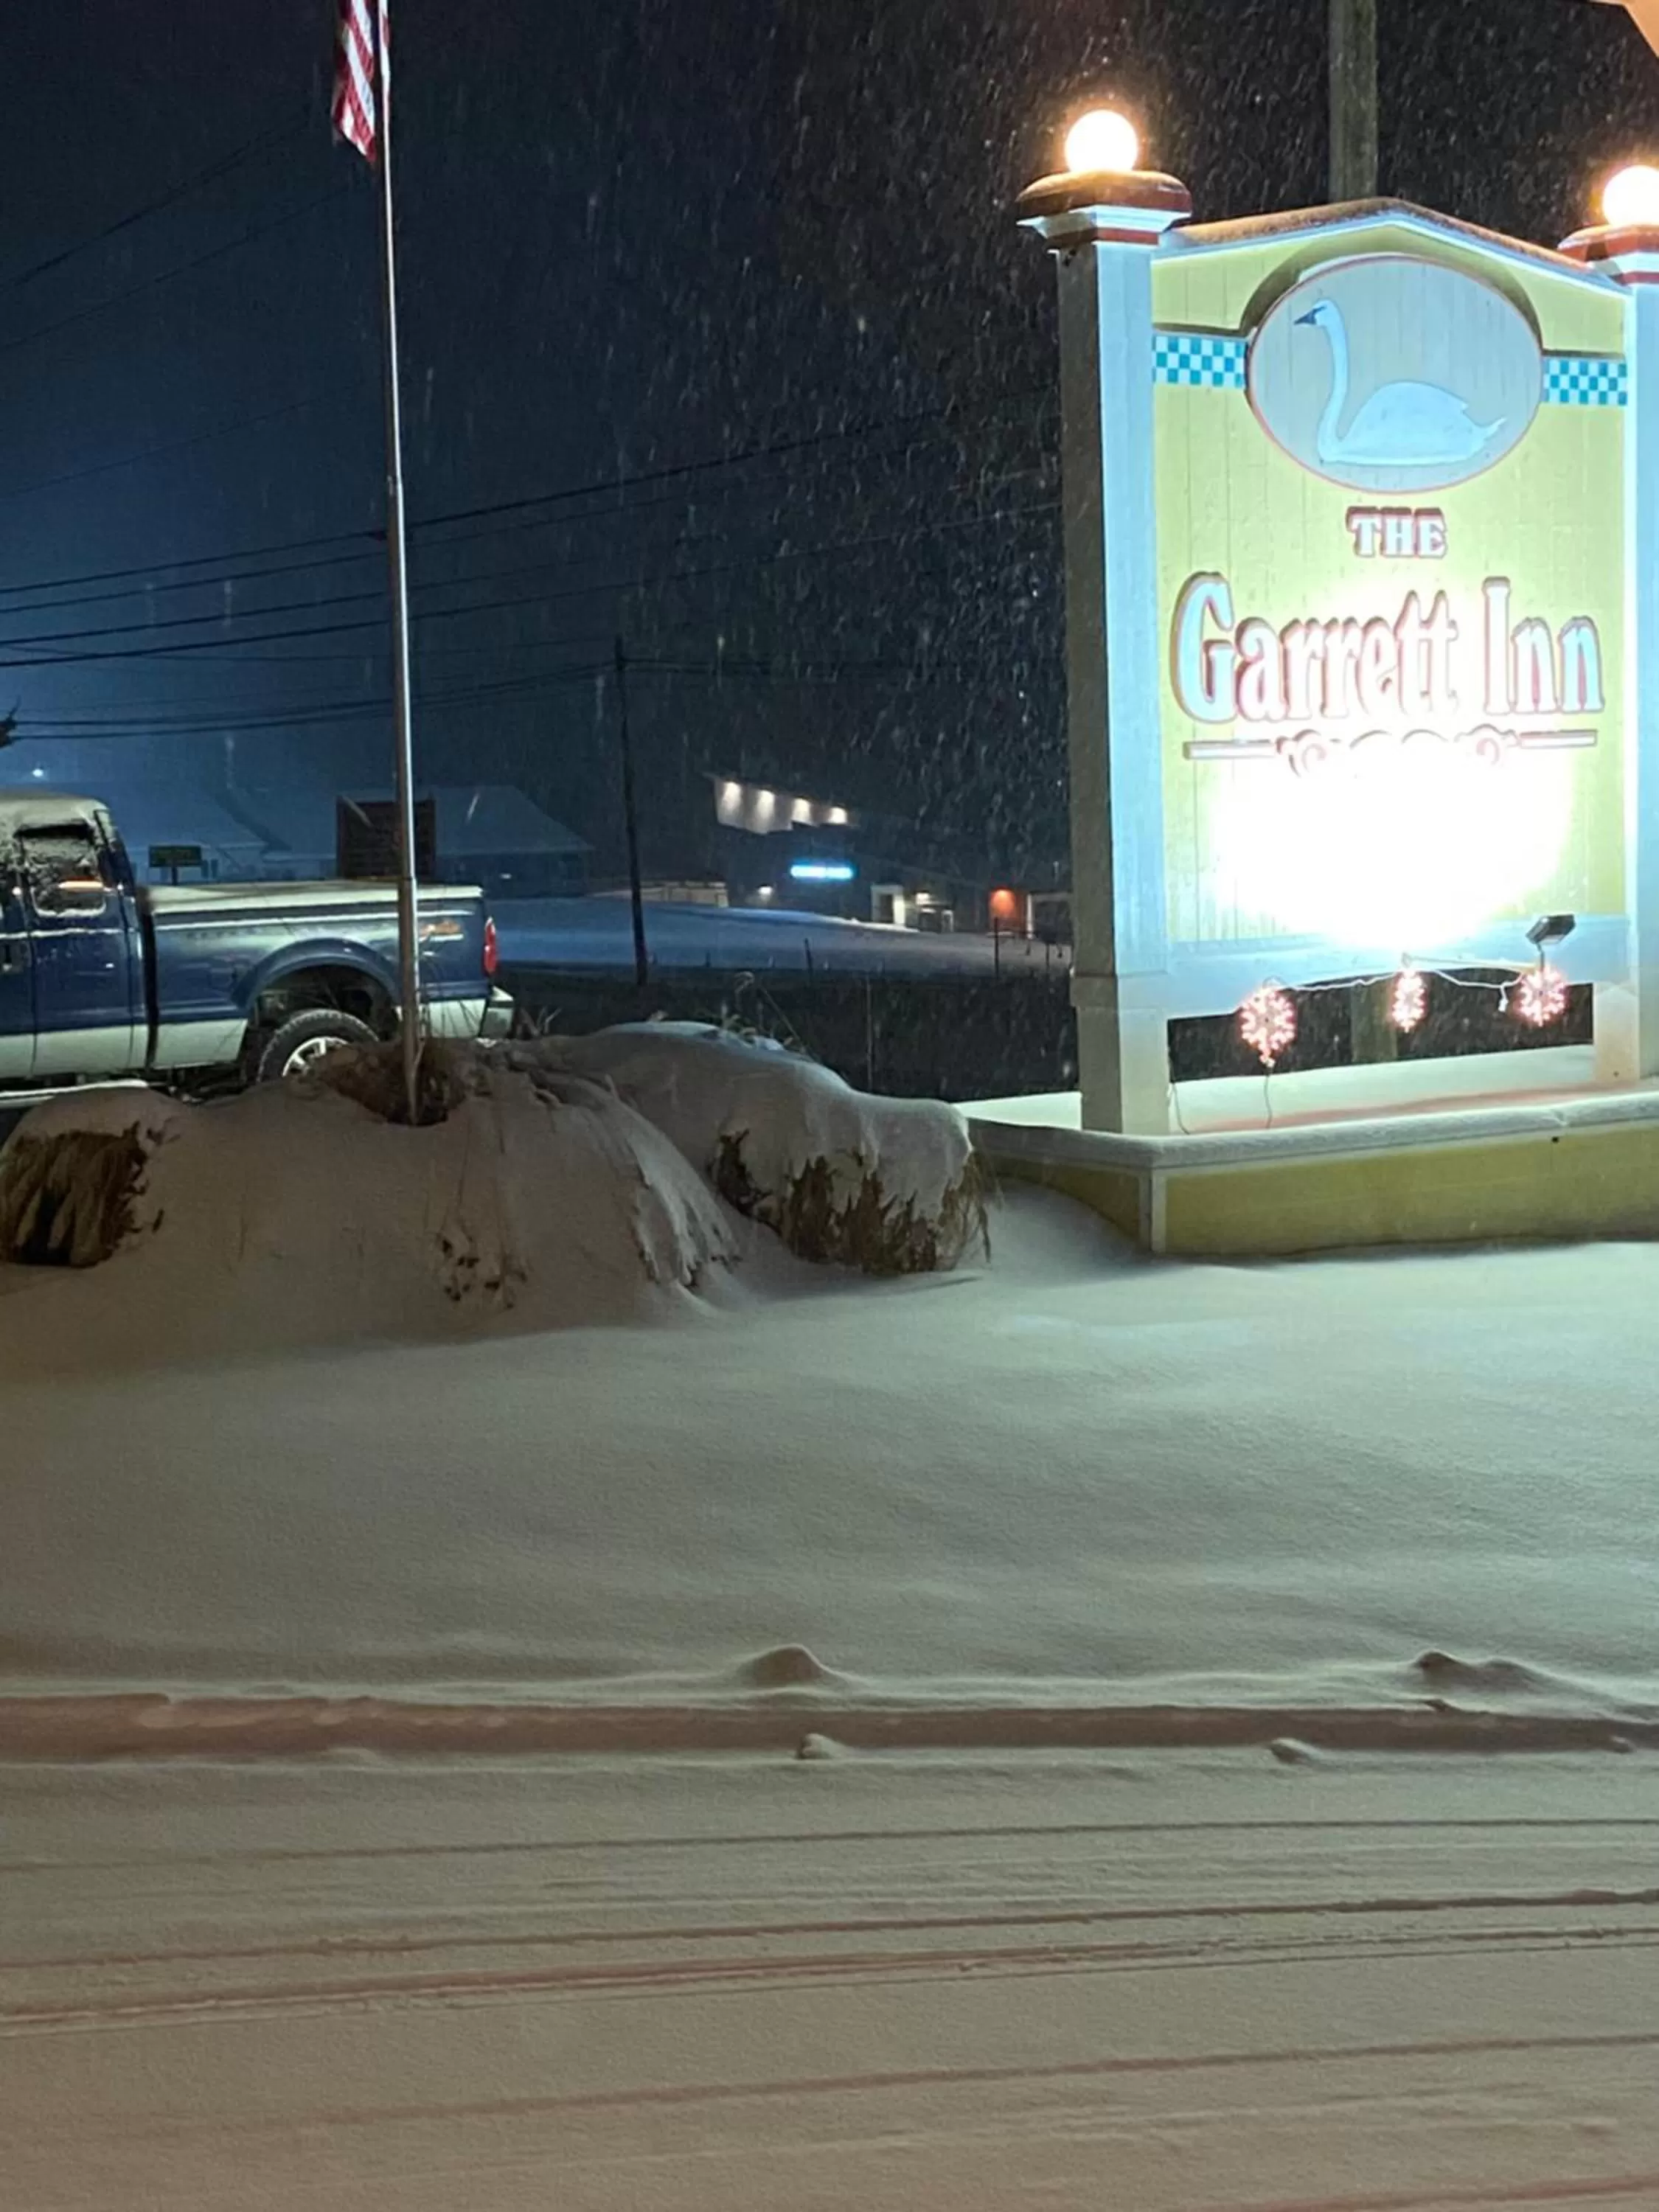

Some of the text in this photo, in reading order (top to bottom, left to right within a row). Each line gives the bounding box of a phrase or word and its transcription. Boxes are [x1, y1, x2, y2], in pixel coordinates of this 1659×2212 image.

[1346, 507, 1447, 558] THE
[1170, 571, 1604, 722] Garrett Inn
